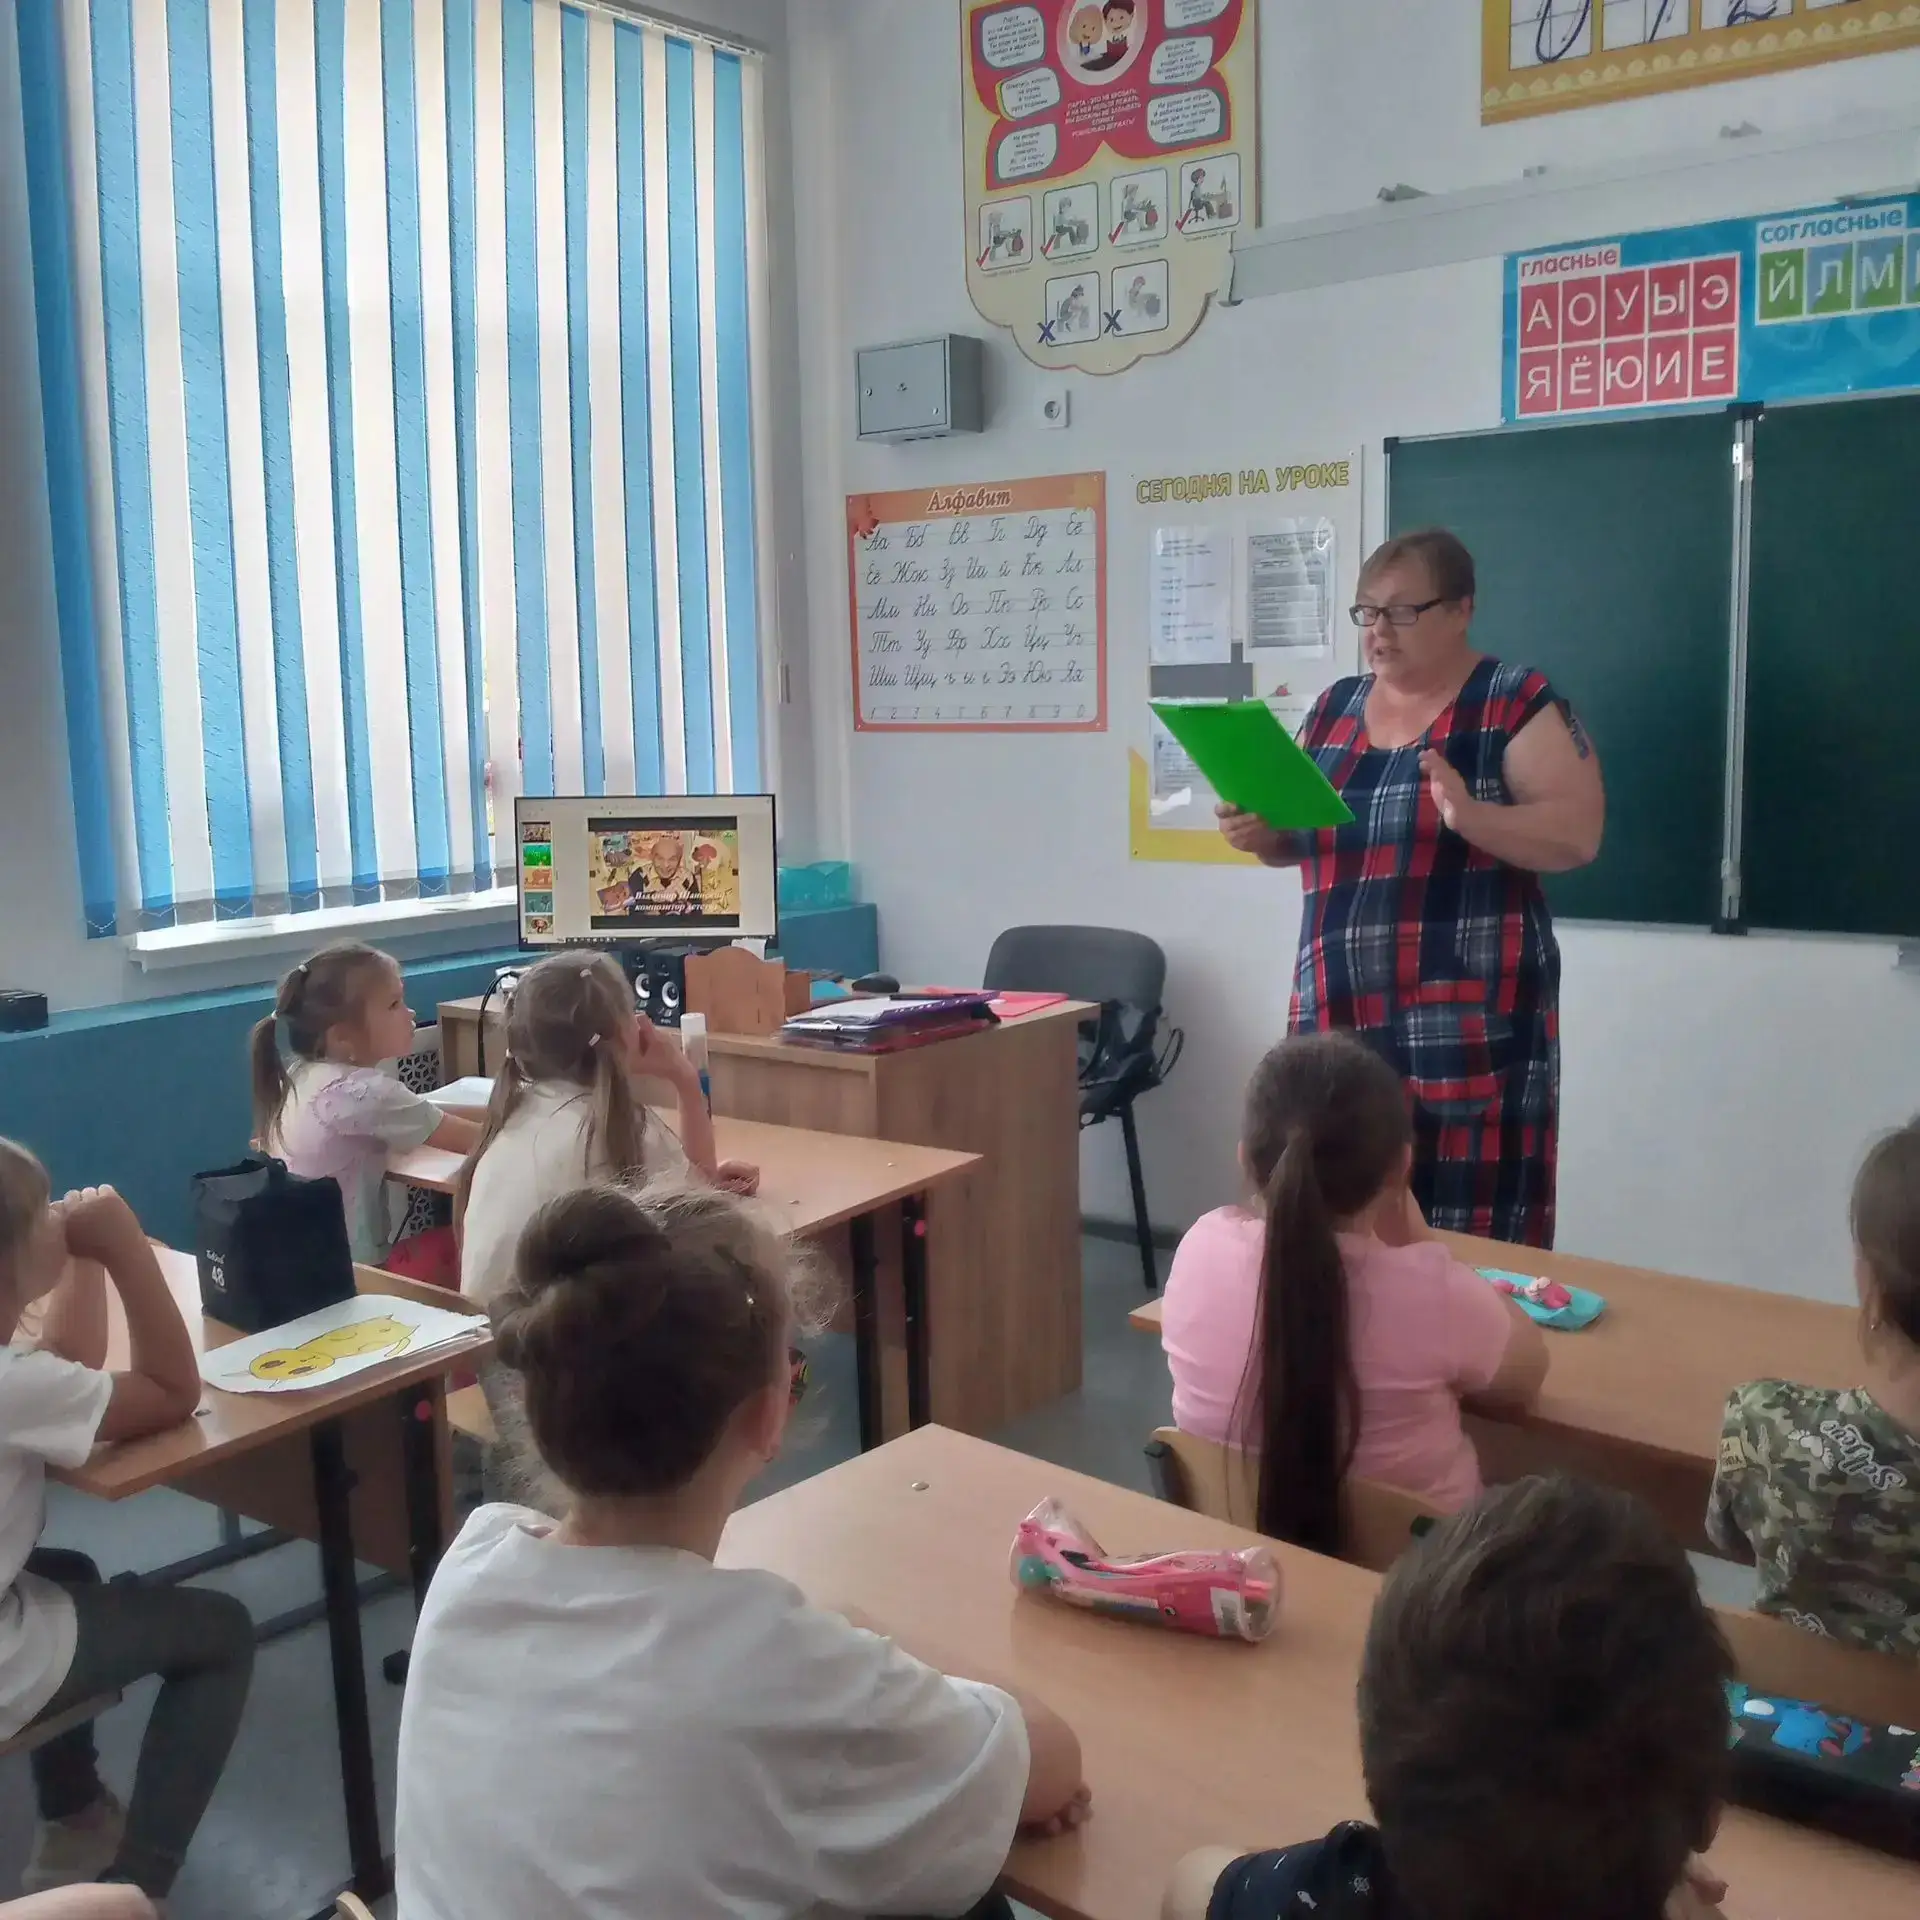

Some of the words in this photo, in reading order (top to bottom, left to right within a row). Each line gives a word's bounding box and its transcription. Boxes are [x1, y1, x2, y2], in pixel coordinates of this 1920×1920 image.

[1760, 209, 1904, 244] согласные
[1520, 247, 1618, 278] гласные
[1768, 259, 1797, 302] Й
[1816, 260, 1844, 296] Л
[1861, 254, 1896, 291] М
[1526, 298, 1553, 333] А
[1568, 293, 1597, 327] О
[1615, 286, 1639, 321] У
[1652, 281, 1686, 317] Ы
[1701, 274, 1730, 310] Э
[1525, 365, 1552, 400] Я
[1569, 356, 1592, 395] Ё
[1605, 355, 1642, 390] Ю
[1656, 350, 1681, 386] И
[1701, 345, 1726, 382] Е
[1136, 472, 1232, 503] СЕГОДНЯ
[1238, 468, 1270, 495] НА
[1276, 461, 1350, 492] УРОКЕ
[928, 488, 1011, 514] Алфавит
[865, 528, 889, 551] Аа
[905, 524, 930, 548] Бб
[891, 560, 928, 584] Жж
[867, 596, 900, 619] Мм
[211, 1265, 225, 1287] 48
